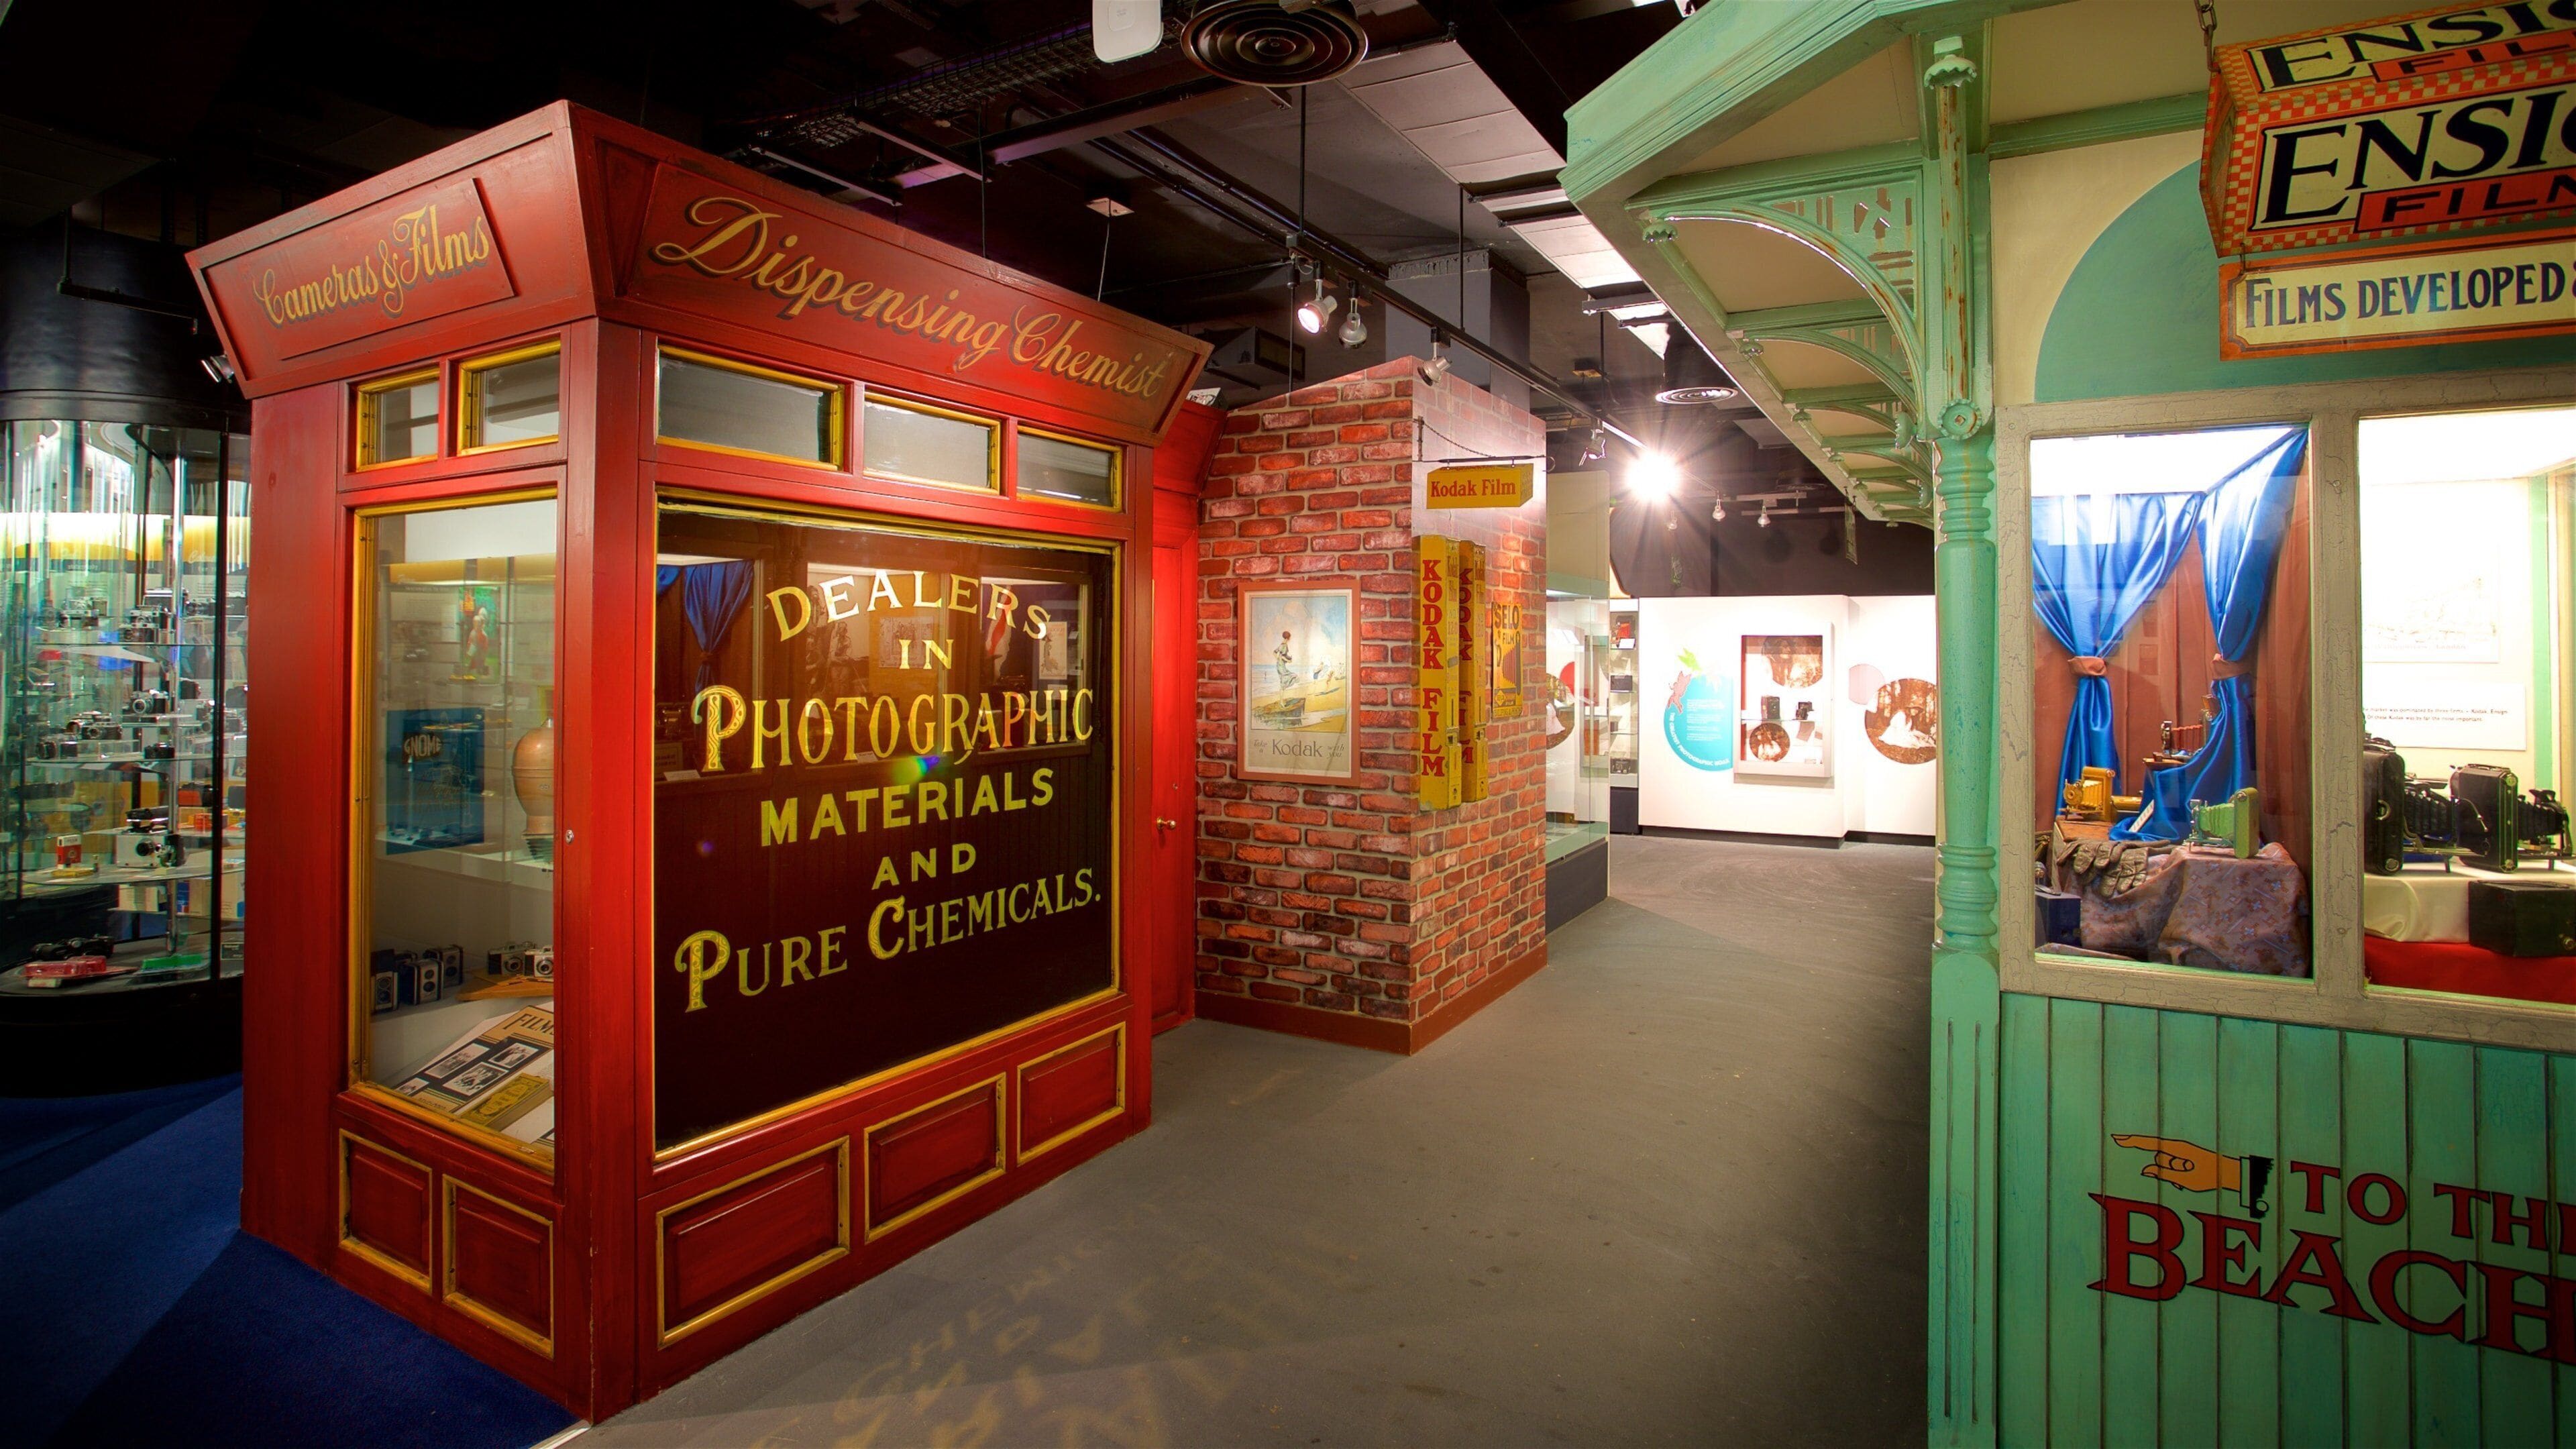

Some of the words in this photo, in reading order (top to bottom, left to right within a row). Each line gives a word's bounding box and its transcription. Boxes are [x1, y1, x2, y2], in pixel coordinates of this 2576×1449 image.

[2400, 32, 2576, 74] FIL
[2263, 90, 2576, 223] ENSI
[252, 256, 379, 323] Cameras
[378, 239, 404, 313] &
[392, 203, 490, 284] Films
[655, 197, 1008, 370] Dispensing
[1018, 305, 1167, 400] Chemist
[2245, 276, 2347, 329] FILMS
[2357, 262, 2566, 319] DEVELOPED
[1430, 480, 1477, 497] Kodak
[1482, 479, 1517, 496] Film
[766, 570, 1051, 641] DEALERS
[1422, 559, 1444, 669] KODAK
[1495, 604, 1520, 629] SELO
[899, 639, 953, 669] IN
[403, 733, 443, 757] GNOME
[691, 684, 1093, 772] PHOTOGRAPHIC
[1272, 739, 1323, 757] Kodak
[1421, 688, 1445, 777] FILM
[761, 767, 1055, 847] MATERIALS
[872, 843, 977, 890] AND
[674, 930, 847, 1012] PURE
[867, 867, 1102, 960] CHEMICALS.
[2290, 1160, 2408, 1226] TO
[2086, 1192, 2576, 1364] BEACH
